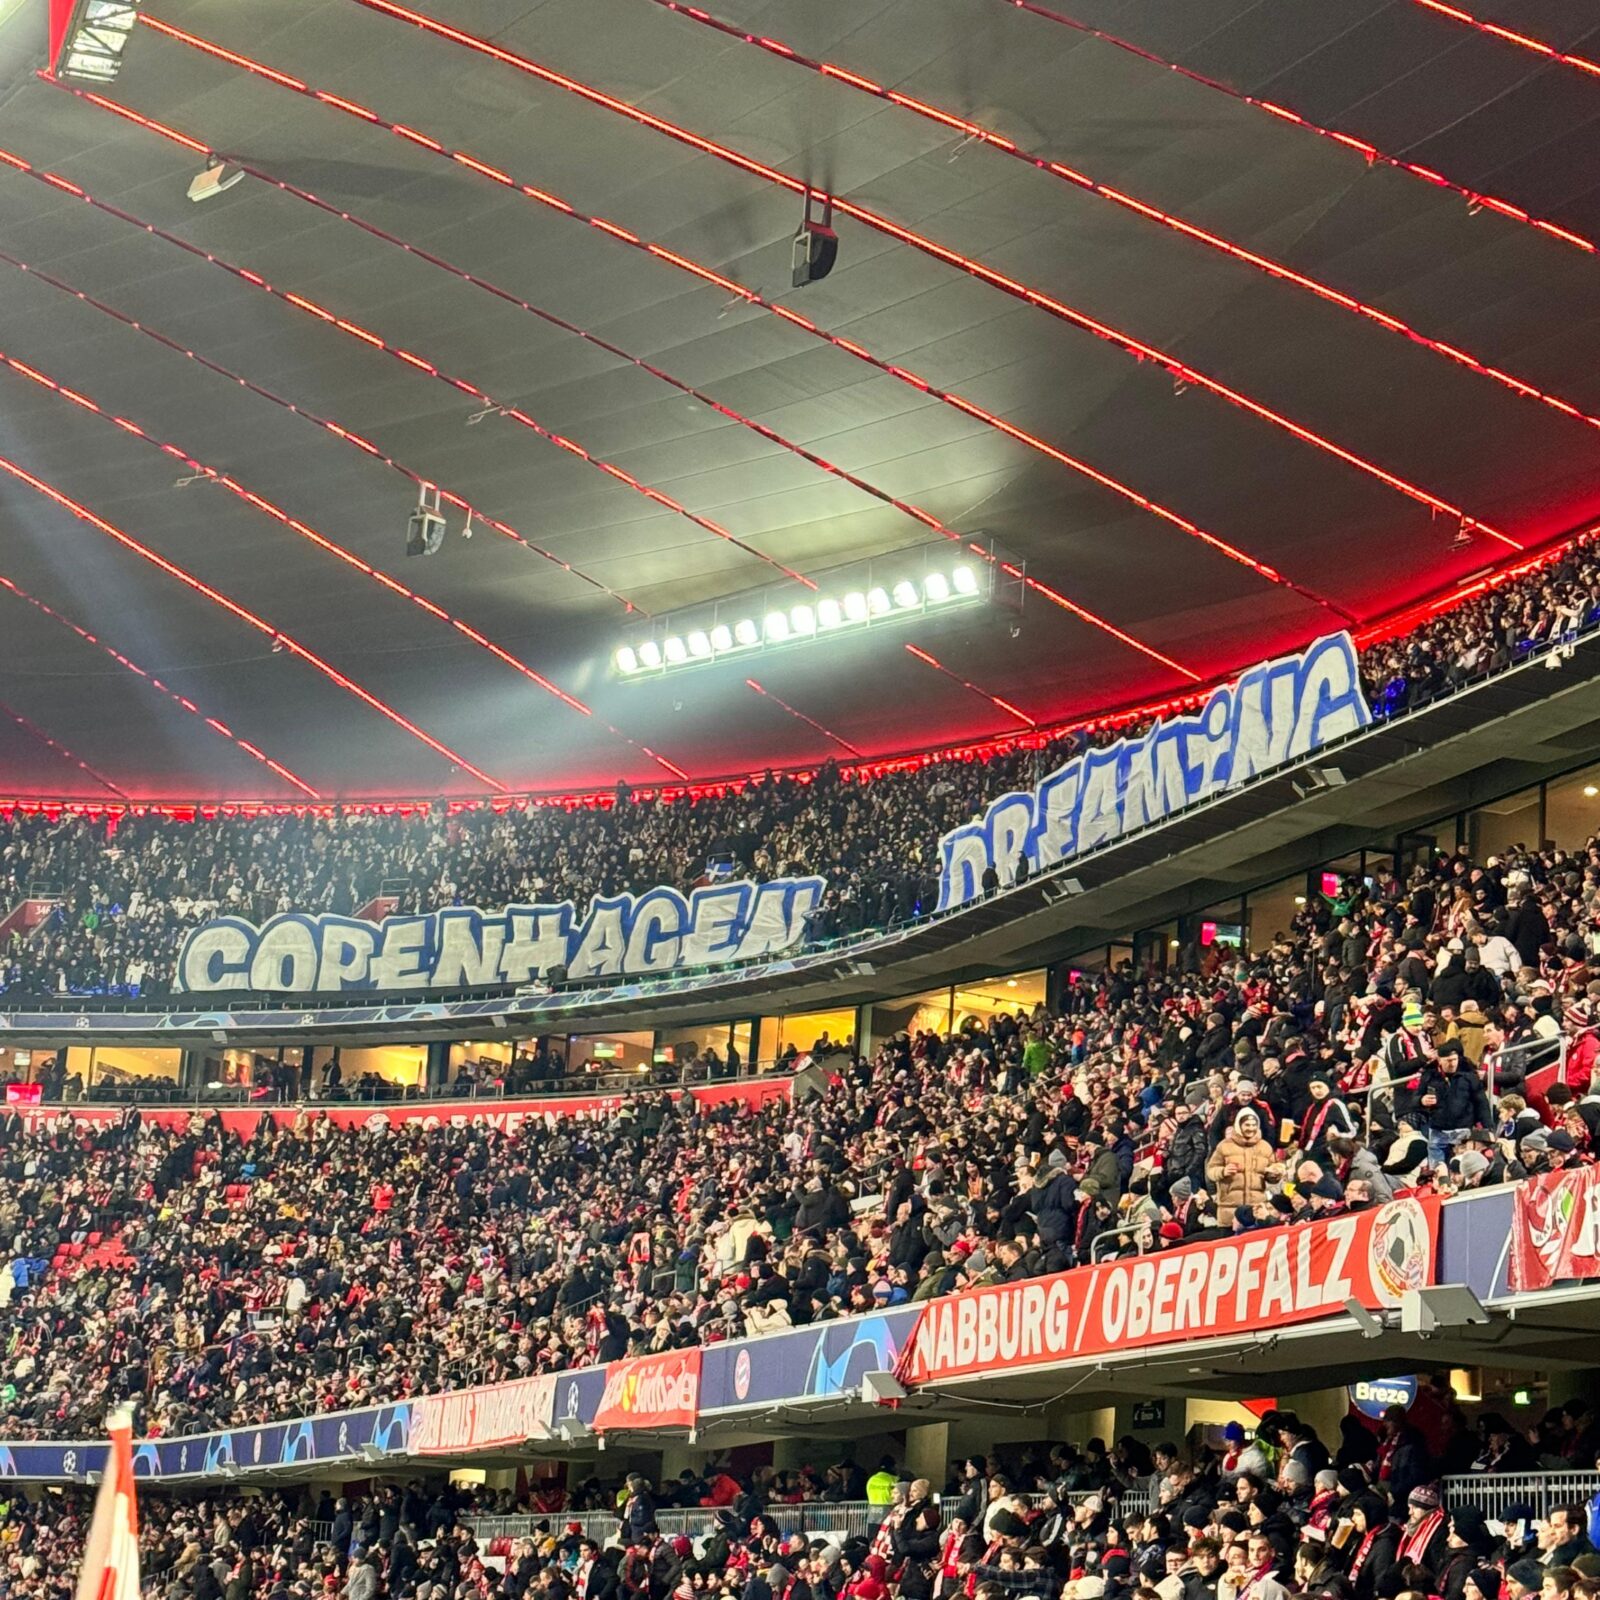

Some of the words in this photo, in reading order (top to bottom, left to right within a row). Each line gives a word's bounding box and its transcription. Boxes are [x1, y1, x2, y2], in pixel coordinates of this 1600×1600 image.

[175, 877, 826, 992] COPENHAGEN
[911, 1279, 1070, 1377] NABBURG
[1102, 1215, 1359, 1343] OBERPFALZ
[1356, 1382, 1409, 1404] Breze
